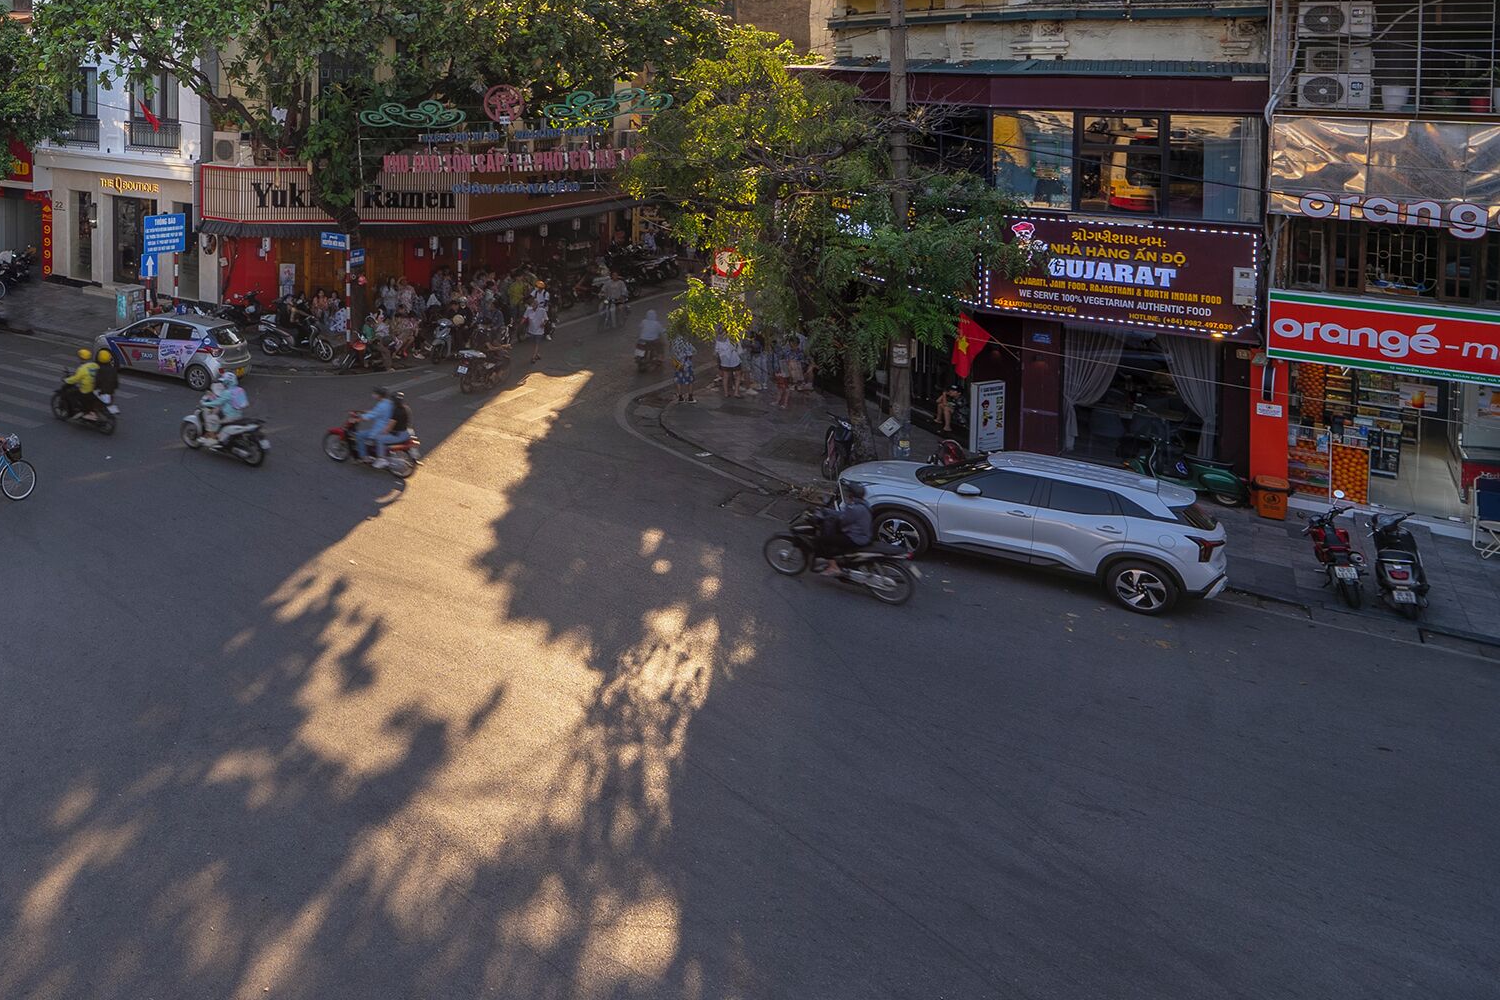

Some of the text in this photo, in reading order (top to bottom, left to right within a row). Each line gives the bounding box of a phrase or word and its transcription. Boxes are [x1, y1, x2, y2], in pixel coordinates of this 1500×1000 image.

[100, 177, 115, 188] THE
[362, 184, 457, 209] Ramen
[1299, 191, 1500, 239] orang
[1050, 242, 1187, 267] NHÀ HÀNG ẤN ĐỘ
[1048, 257, 1177, 288] GUJARAT
[1019, 288, 1212, 317] WE SERVE 100% VEGETARIAN AUTHENTIC FOOD
[1089, 282, 1135, 296] RAJASTHANI
[1143, 289, 1169, 300] NORTH
[1171, 291, 1198, 303] INDIAN
[1200, 294, 1222, 305] FOOD
